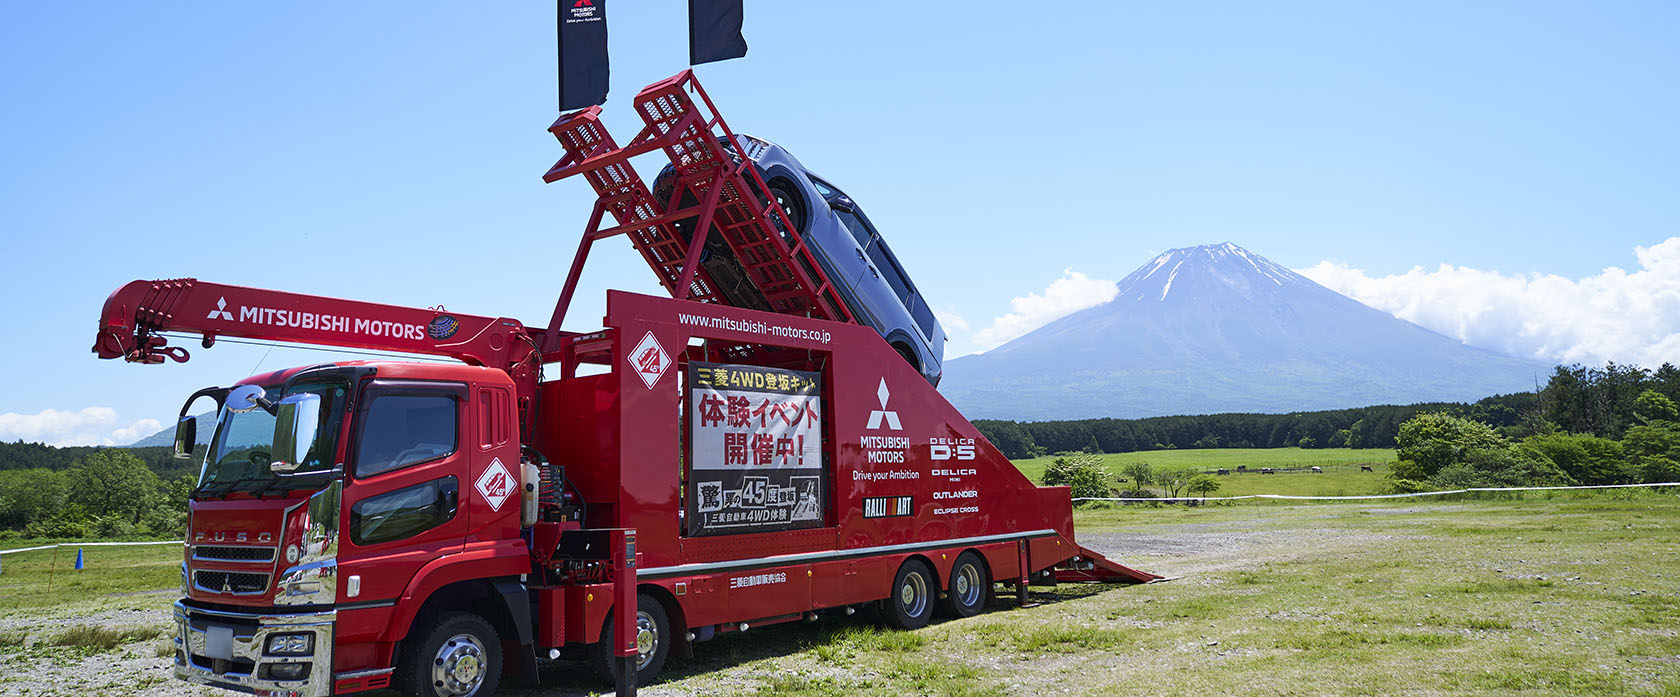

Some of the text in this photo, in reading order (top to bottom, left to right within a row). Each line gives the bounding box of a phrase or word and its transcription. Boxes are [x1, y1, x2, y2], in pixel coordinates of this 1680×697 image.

[240, 305, 350, 333] MITSUBISHI
[354, 319, 425, 340] MOTORS
[678, 312, 832, 344] www.mitsubishi-motors.co.jp
[698, 368, 816, 392] 三菱4WD登坂キット
[698, 394, 818, 429] 体験イベント
[860, 436, 910, 449] MITSUBISHI
[868, 451, 905, 464] MOTORS
[930, 445, 976, 460] D:5
[852, 470, 920, 482] Drive your Ambition
[932, 490, 978, 499] OUTLANDER
[196, 532, 272, 542] FUSO
